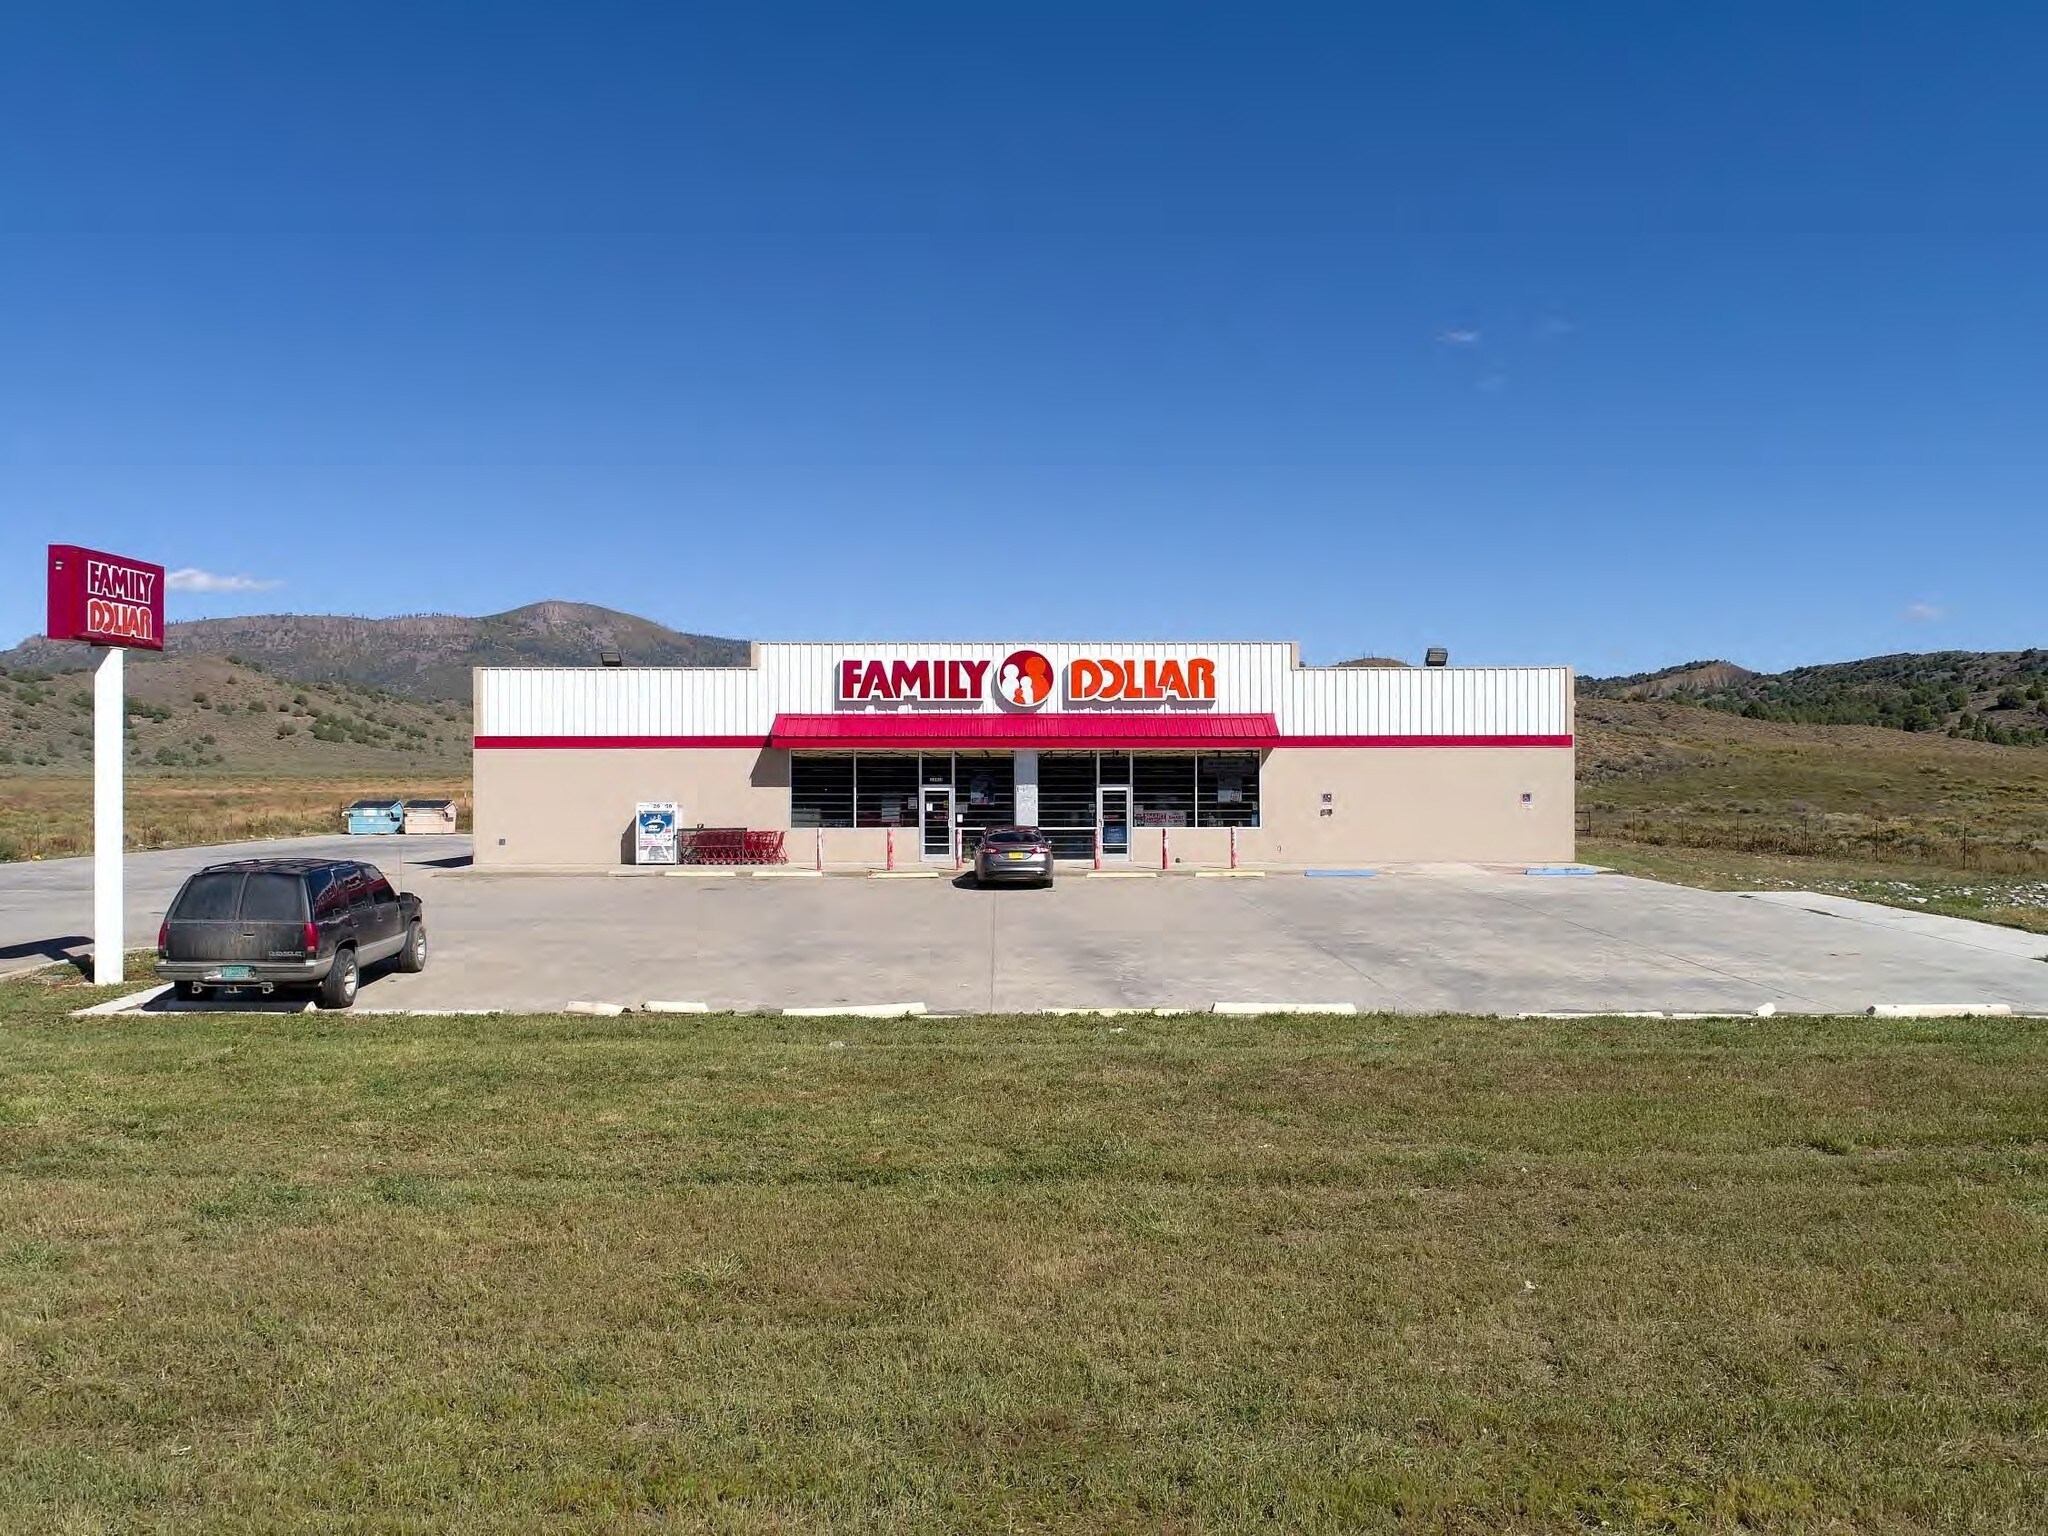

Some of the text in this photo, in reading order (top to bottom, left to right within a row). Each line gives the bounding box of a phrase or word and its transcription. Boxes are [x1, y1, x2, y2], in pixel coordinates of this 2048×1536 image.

[87, 560, 155, 604] FAMILY
[87, 598, 153, 640] DOLLAR
[841, 657, 1217, 700] FAMILY DOLLAR
